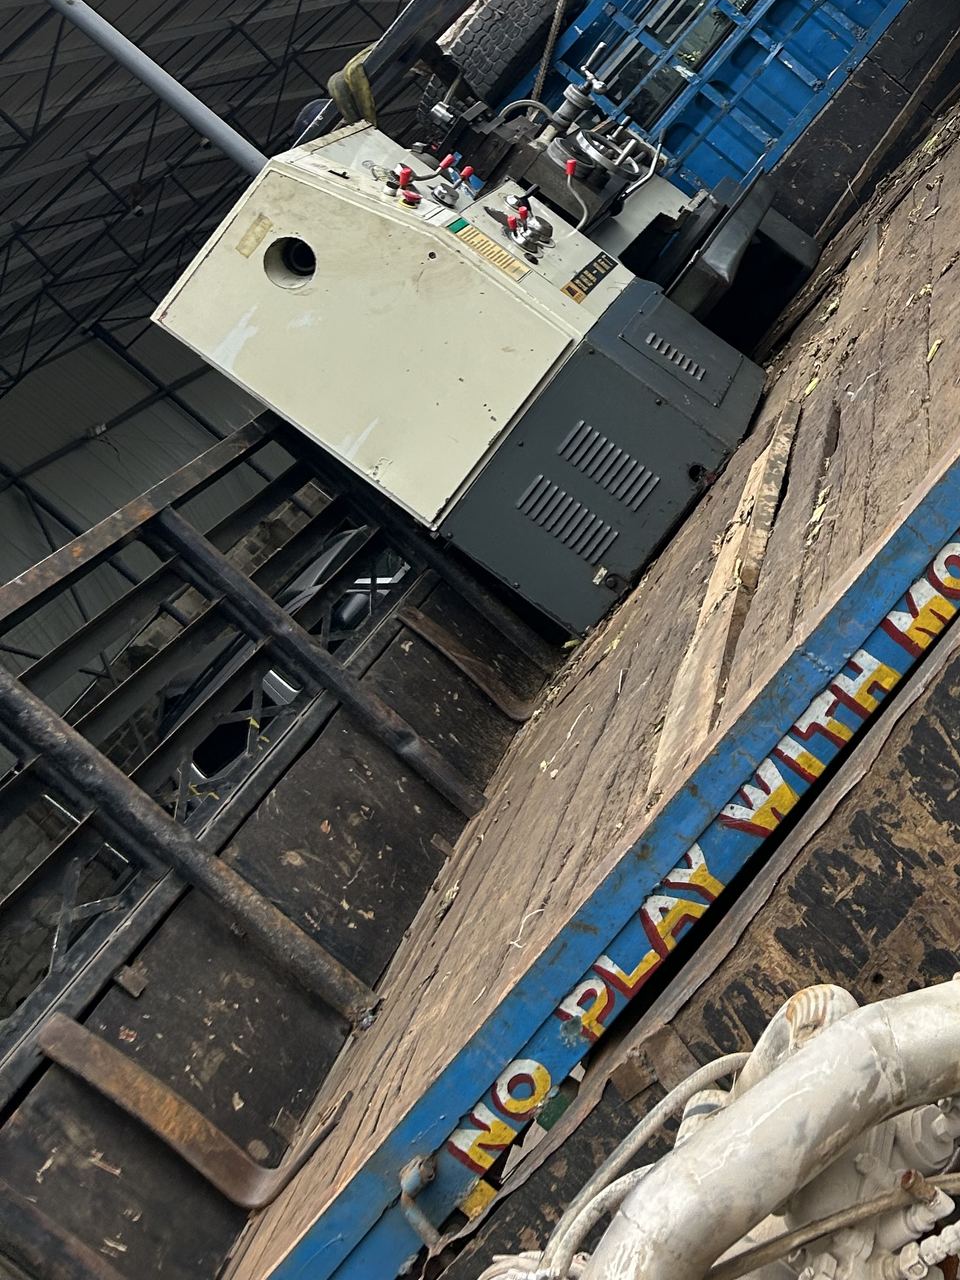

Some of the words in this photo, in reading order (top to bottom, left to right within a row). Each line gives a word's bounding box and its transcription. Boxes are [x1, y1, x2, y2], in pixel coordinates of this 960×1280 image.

[447, 1058, 551, 1175] NO
[554, 842, 726, 1041] PLAY
[719, 649, 902, 838] WITH
